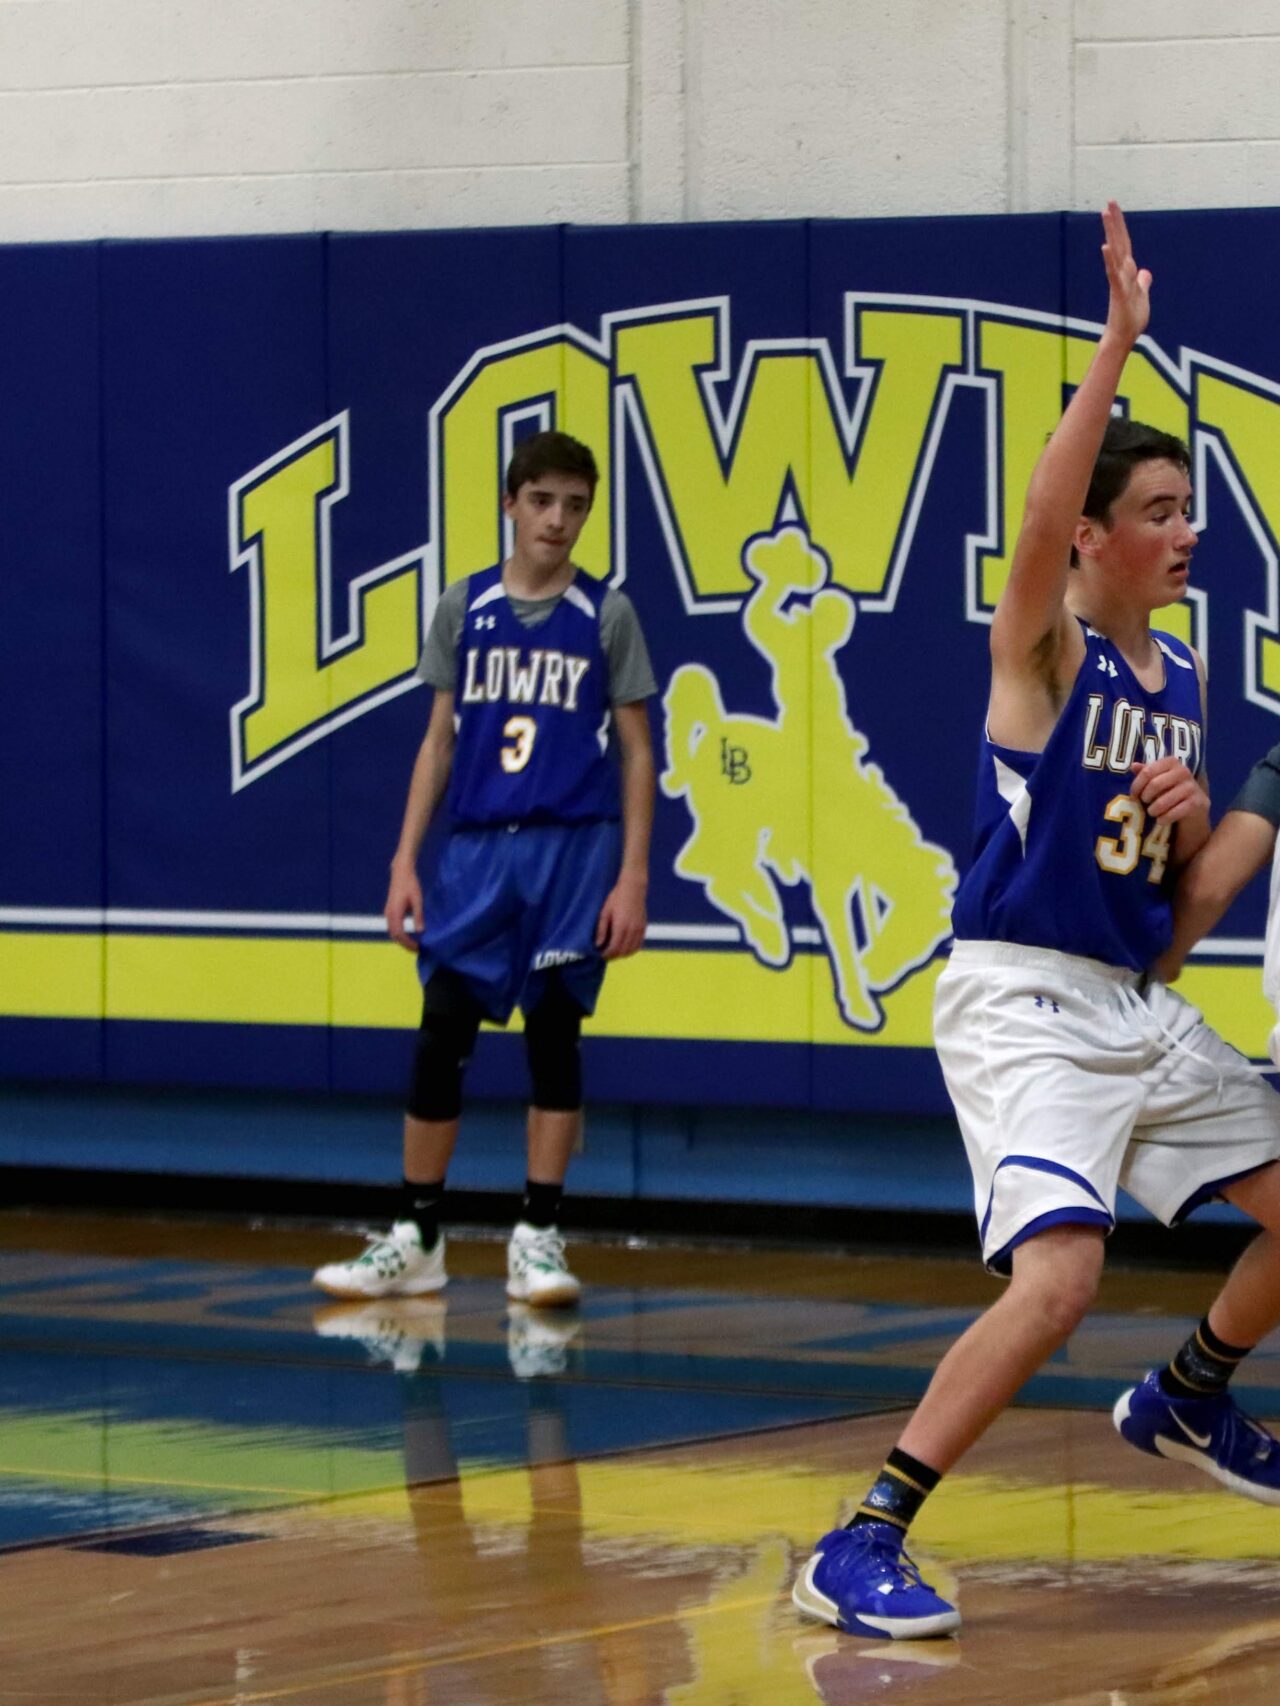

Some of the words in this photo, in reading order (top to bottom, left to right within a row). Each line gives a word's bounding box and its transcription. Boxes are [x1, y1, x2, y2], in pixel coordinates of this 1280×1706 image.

[462, 647, 590, 712] LOWRY
[501, 715, 537, 773] 3
[1095, 794, 1173, 884] 34
